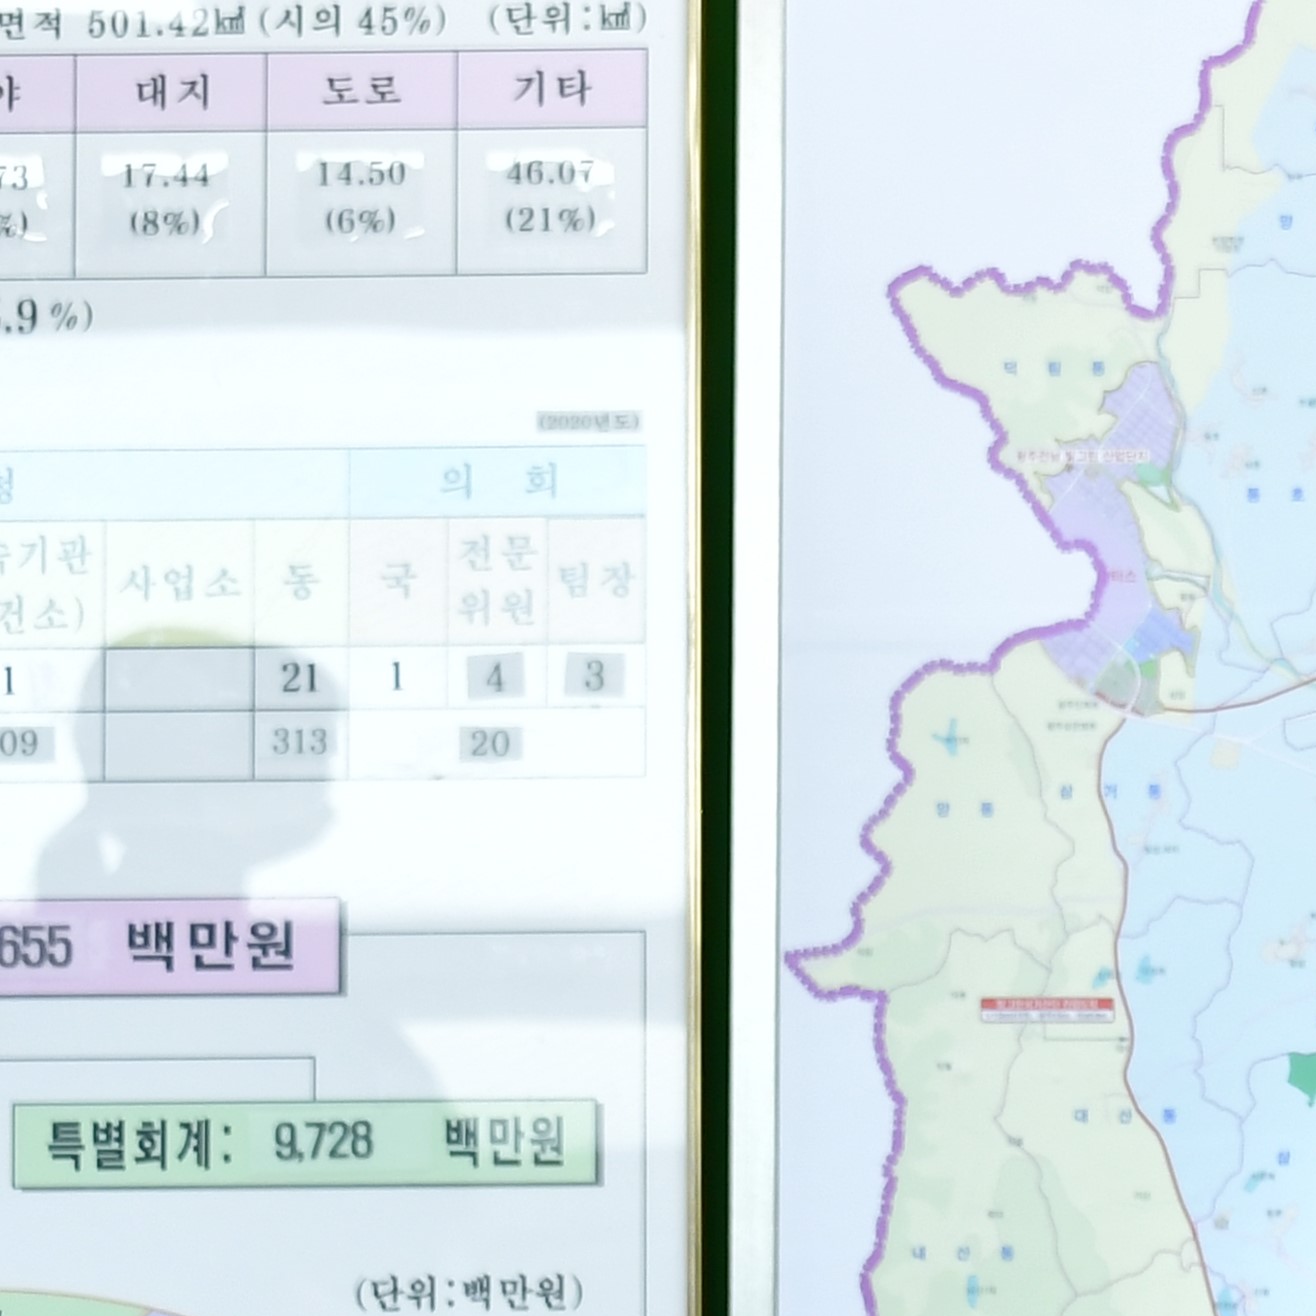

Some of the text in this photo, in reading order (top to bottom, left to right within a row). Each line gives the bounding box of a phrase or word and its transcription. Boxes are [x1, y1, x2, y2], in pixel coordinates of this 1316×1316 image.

[259, 3, 342, 38] (시의
[358, 4, 448, 37] 45%)
[135, 72, 212, 110] 대지
[321, 74, 402, 107] 도로
[514, 68, 593, 108] 기타
[120, 160, 210, 190] 17.44
[316, 160, 407, 189] 14.50
[506, 160, 595, 186] 46.07
[129, 209, 201, 238] (8%)
[325, 207, 396, 236] (6%)
[505, 206, 596, 235] (21%)
[458, 533, 538, 572] 전문
[118, 564, 242, 601] 사업소
[283, 562, 320, 600] 동
[380, 560, 418, 598] 국
[558, 561, 637, 600] 팀장
[457, 588, 536, 626] 위원
[281, 662, 319, 694] 21
[486, 662, 507, 692] 4
[584, 660, 607, 691] 3
[272, 727, 329, 756] 313
[470, 730, 511, 757] 20
[128, 920, 296, 972] 백만원
[48, 1115, 565, 1172] 특별회계: 9,728 백만원
[354, 1271, 584, 1316] (단위:백만원)
